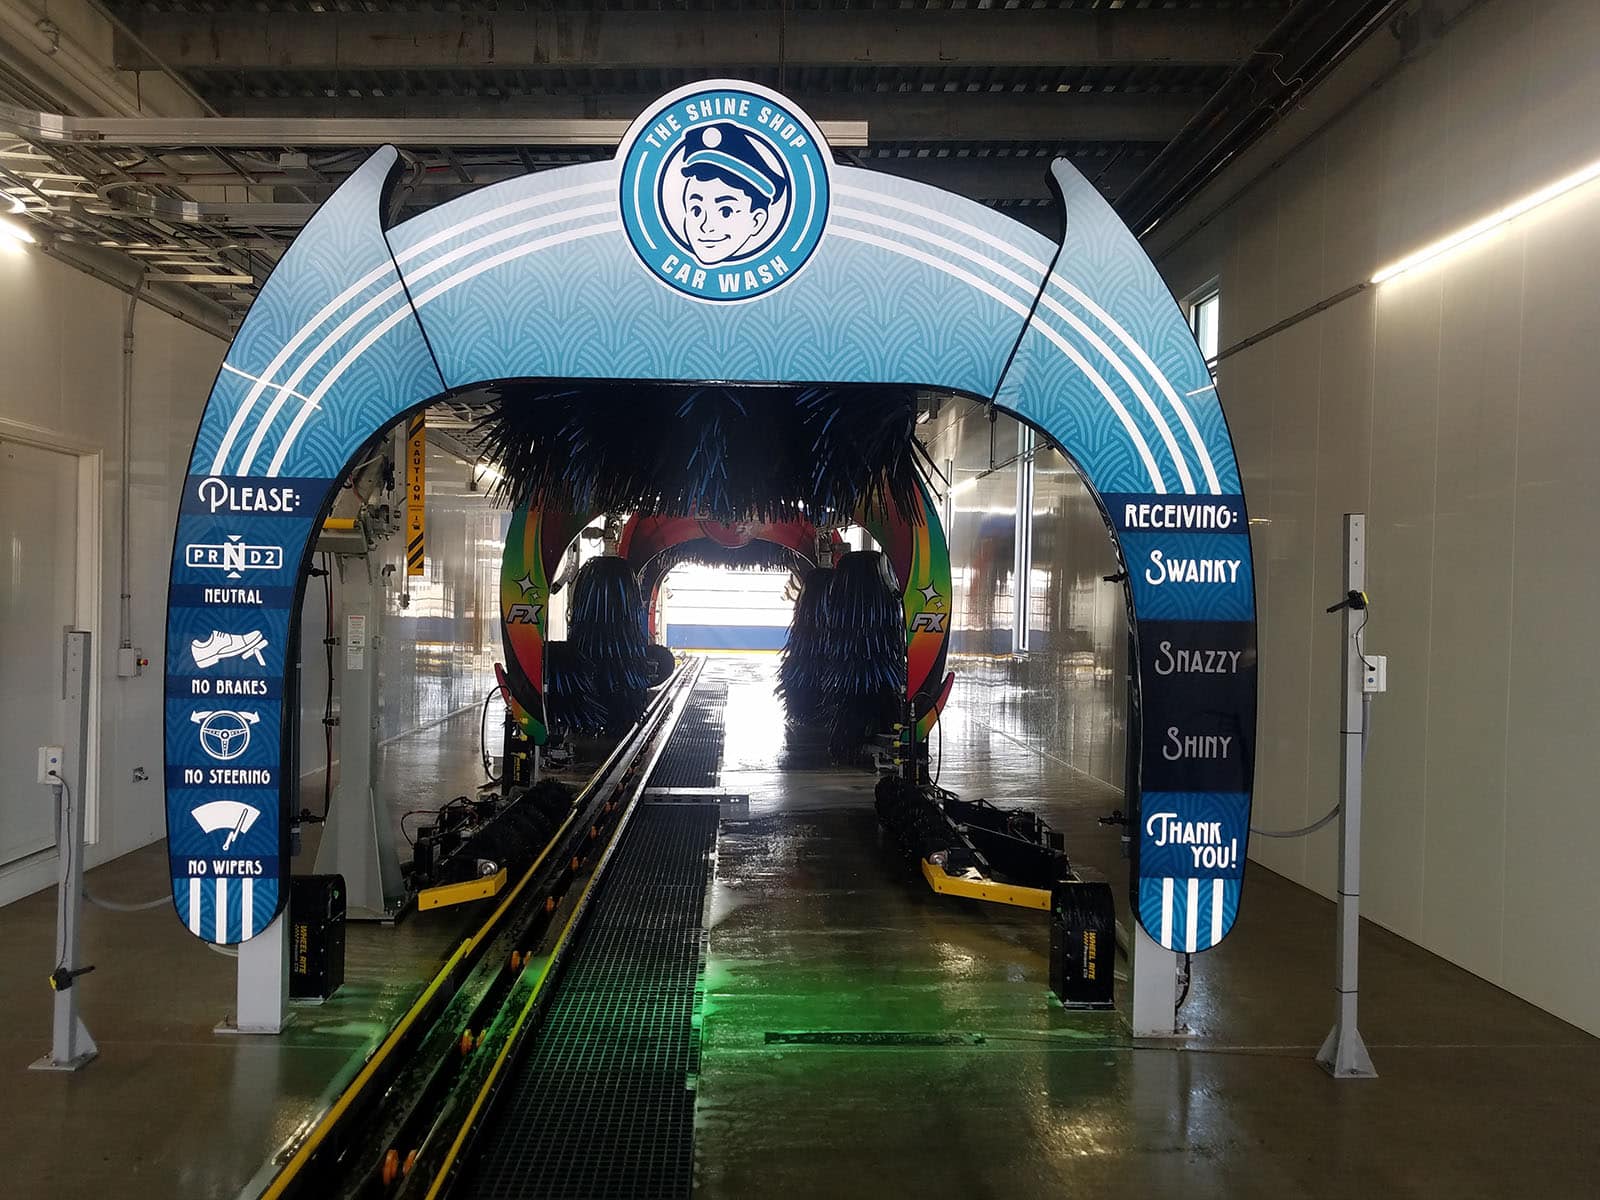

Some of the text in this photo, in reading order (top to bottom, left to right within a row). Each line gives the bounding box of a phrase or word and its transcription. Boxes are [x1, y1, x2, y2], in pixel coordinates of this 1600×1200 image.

[645, 98, 807, 149] THE SHINE SHOP
[661, 254, 790, 293] CAR WASH
[413, 440, 421, 501] CAUTION
[198, 477, 301, 513] PLEASE:
[1125, 504, 1238, 529] RECEIVING:
[1145, 549, 1241, 585] SWANKY
[204, 588, 263, 604] NEUTRAL
[507, 604, 543, 624] FX
[910, 612, 947, 632] FX
[1154, 641, 1242, 675] SNAZZY
[192, 679, 268, 695] NO BRAKES
[1162, 726, 1232, 760] SHINY
[185, 769, 271, 784] NO STEERING
[1146, 812, 1222, 847] THANK
[188, 860, 263, 875] NO WIPERS
[1191, 838, 1237, 869] YOU!
[299, 925, 308, 954] WHEEL
[1088, 931, 1097, 960] WHEEL
